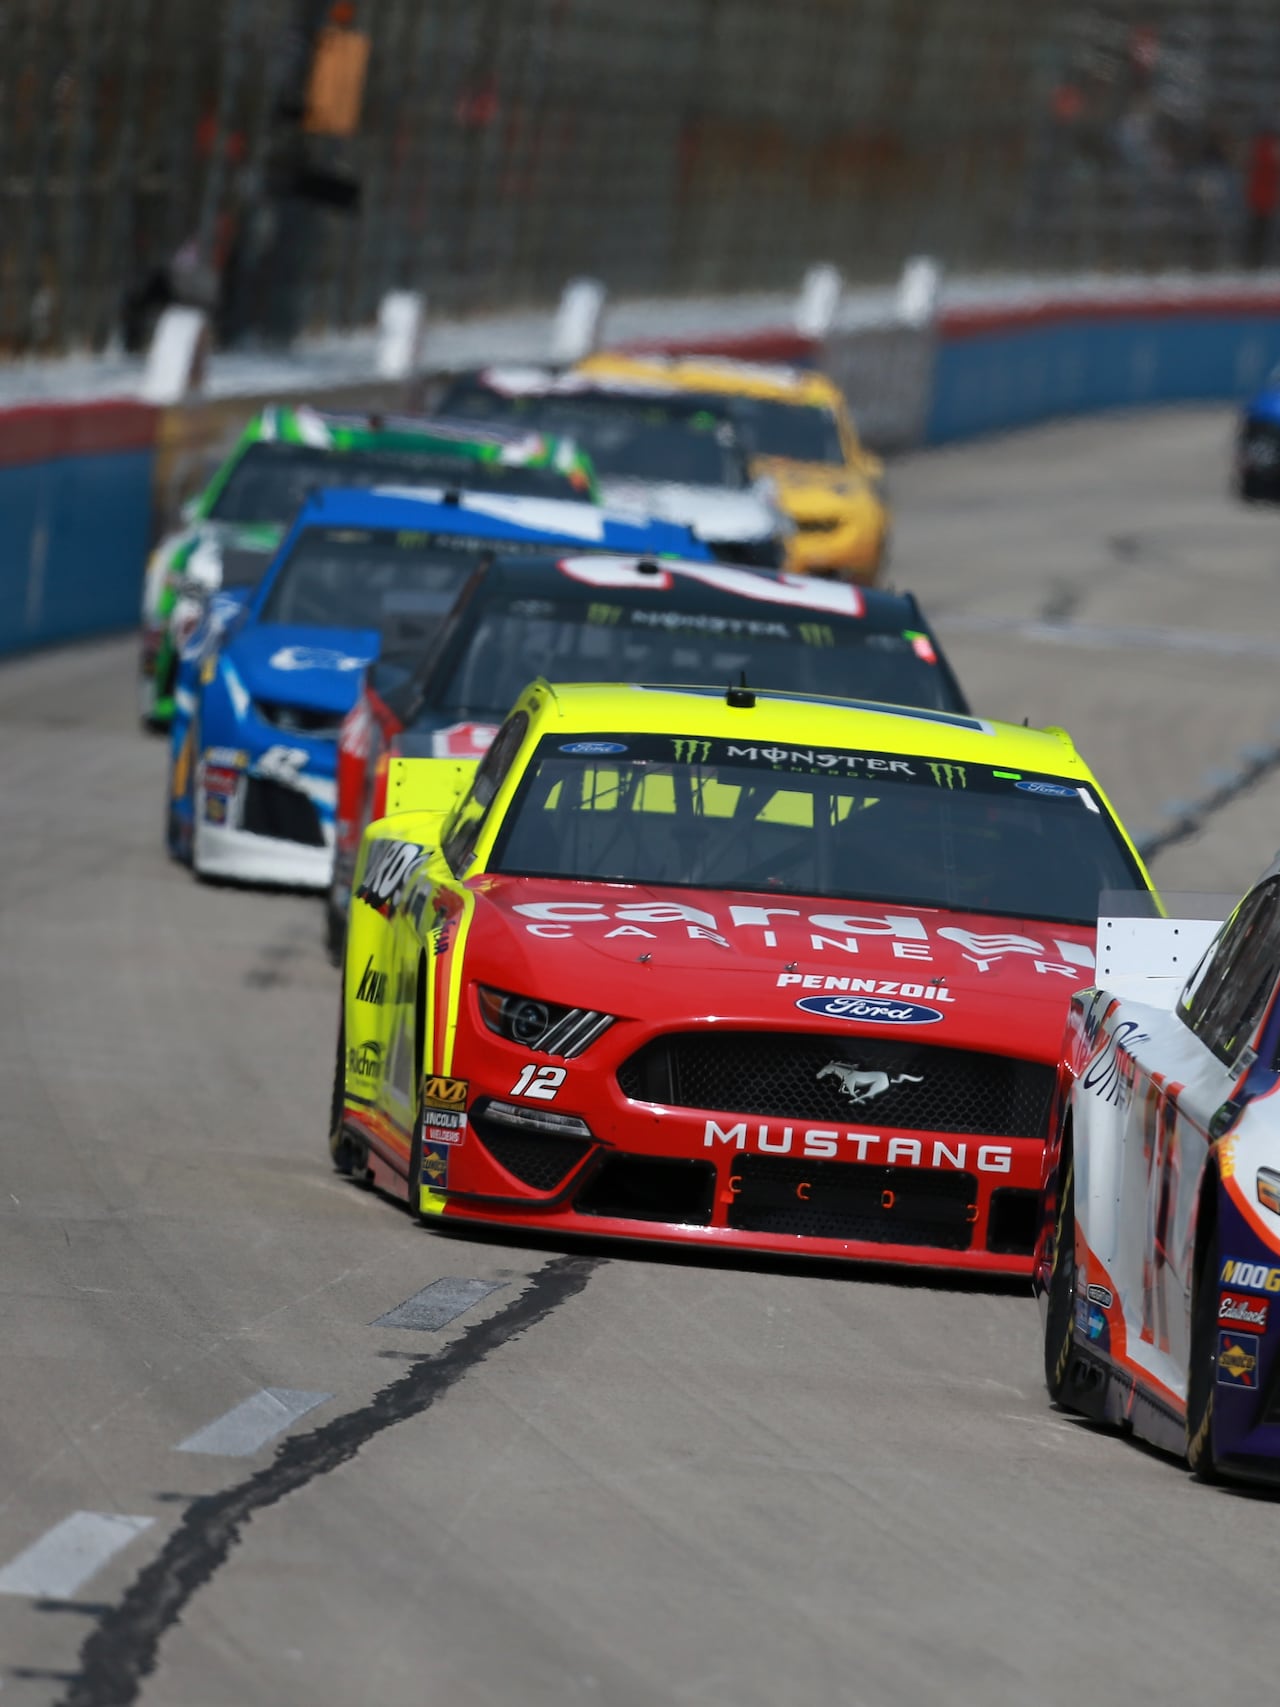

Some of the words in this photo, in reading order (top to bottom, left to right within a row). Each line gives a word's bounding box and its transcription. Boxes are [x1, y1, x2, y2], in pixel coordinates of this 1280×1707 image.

[727, 746, 916, 776] MONSTER
[776, 973, 956, 1003] PENNZOIL
[816, 996, 922, 1023] Ford
[508, 1063, 568, 1101] 12
[424, 1111, 460, 1129] LINCOLN
[703, 1119, 1012, 1173] MUSTANG
